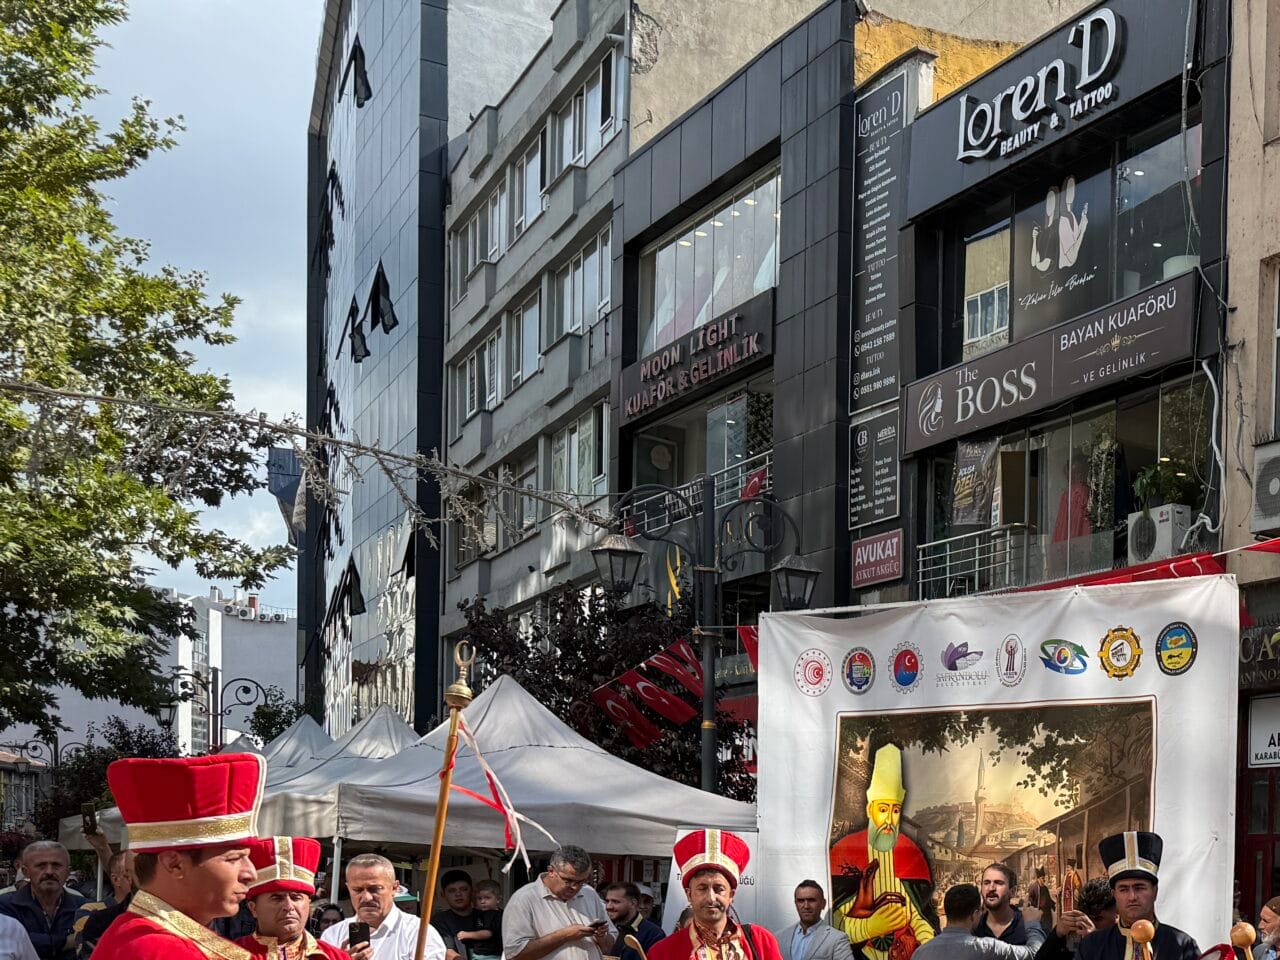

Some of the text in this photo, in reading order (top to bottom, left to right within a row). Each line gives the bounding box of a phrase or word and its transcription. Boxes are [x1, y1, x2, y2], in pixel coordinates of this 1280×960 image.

[1000, 82, 1113, 156] BEAUTY & TATTOO
[1060, 287, 1178, 351] BAYAN KUAFÖRÜ
[625, 331, 759, 417] KUAFÖR & GELİNLİK
[640, 344, 681, 382] MOON
[956, 366, 978, 386] The
[1083, 351, 1147, 384] VE GELİNLİK
[954, 360, 1037, 425] BOSS
[855, 537, 898, 567] AVUKAT
[855, 567, 876, 581] AYKUT
